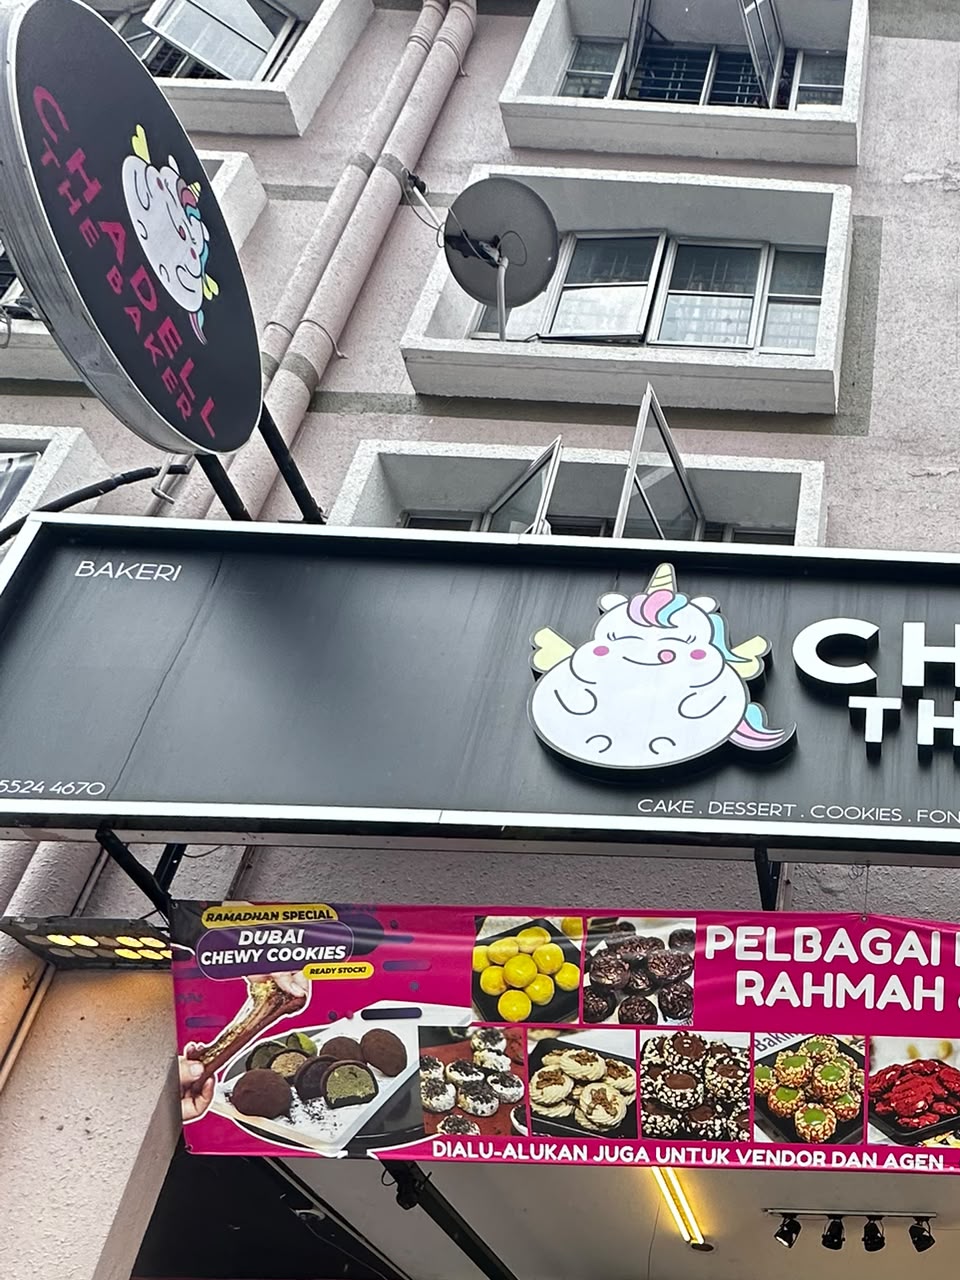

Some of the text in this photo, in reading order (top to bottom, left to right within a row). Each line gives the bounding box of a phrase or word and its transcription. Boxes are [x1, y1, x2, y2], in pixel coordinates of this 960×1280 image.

[33, 86, 216, 438] CHADELL
[41, 141, 194, 421] THE BAKER
[75, 560, 181, 582] BAKERI
[0, 780, 106, 796] 5524 4670
[638, 799, 694, 814] CAKE
[708, 801, 797, 818] DESSERT
[810, 805, 902, 822] COOKIES
[205, 910, 334, 922] RAMADHAN SPECIAL
[238, 928, 304, 946] DUBAI
[704, 925, 941, 967] PELBAGAI
[200, 946, 346, 966] CHEWY COOKIES
[309, 967, 336, 975] READY
[735, 970, 944, 1013] RAHMAH
[432, 1140, 588, 1162] DIALU-ALUKAN
[593, 1145, 650, 1164] JUGA
[655, 1147, 728, 1166] UNTUK
[735, 1148, 826, 1168] VENDOR
[831, 1151, 878, 1169] DAN
[883, 1152, 945, 1170] AGEN
